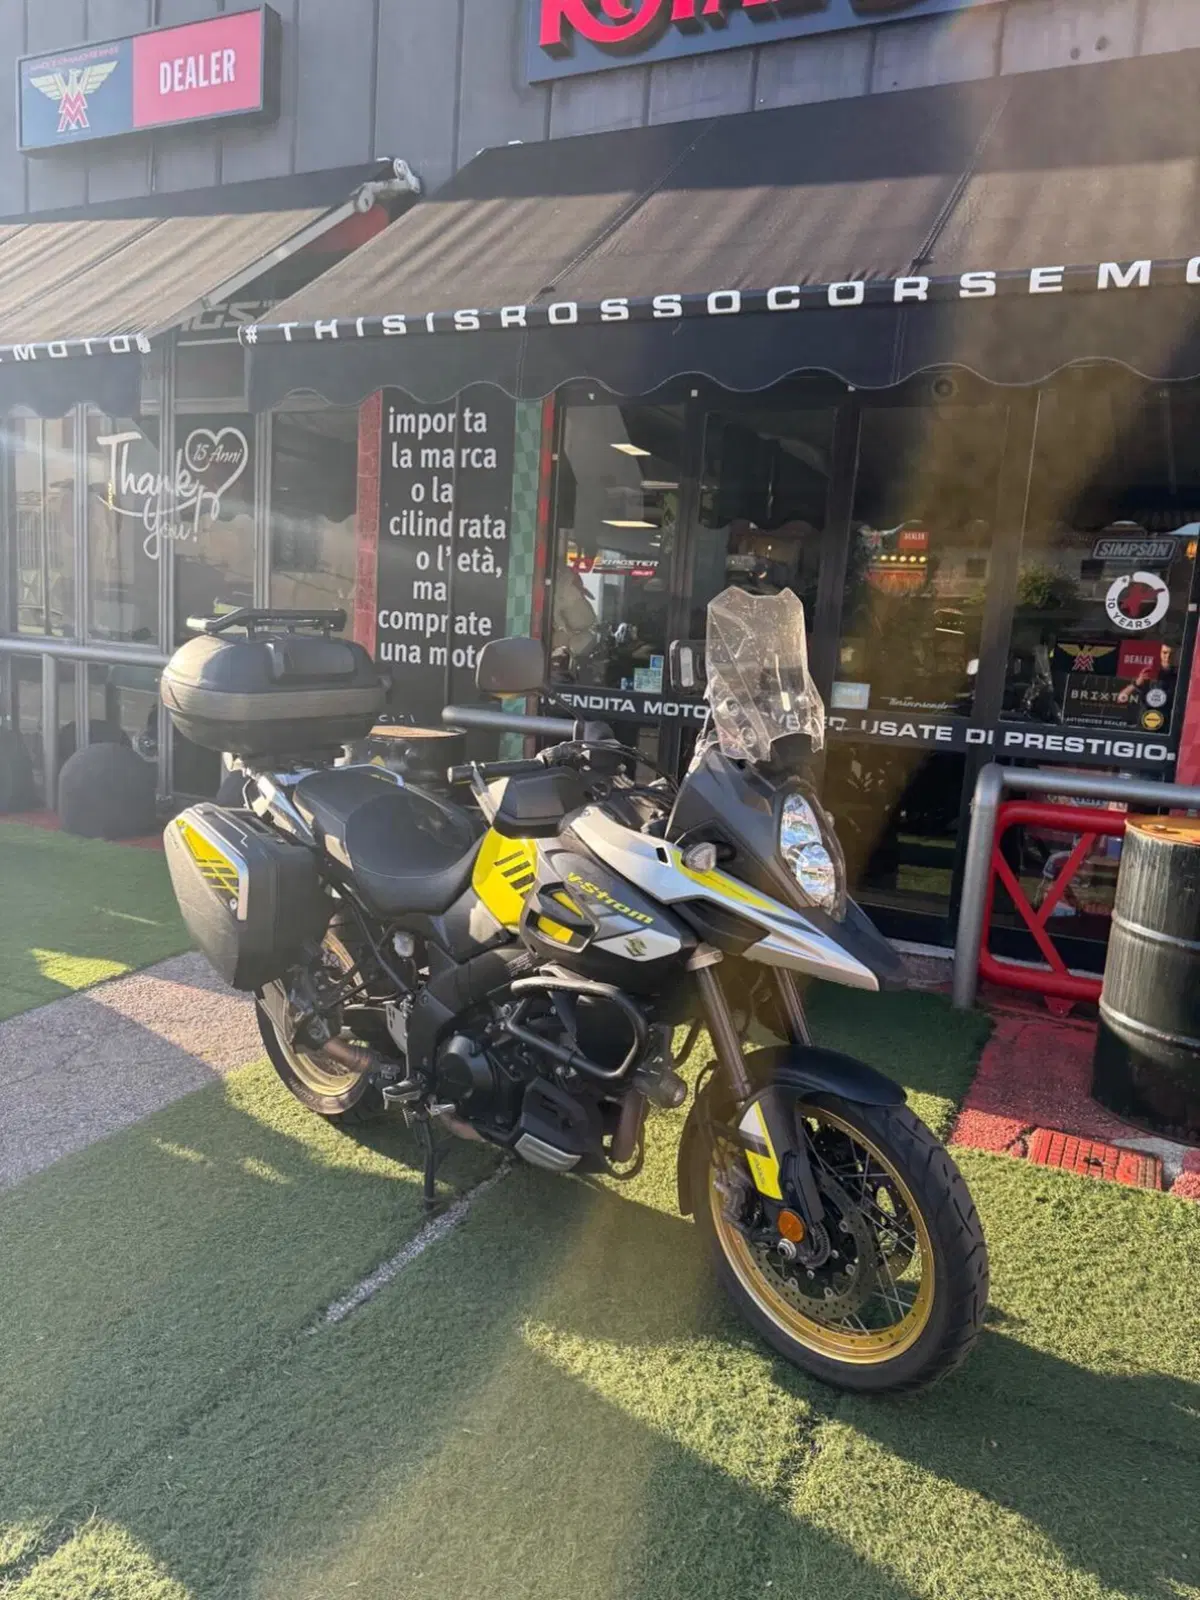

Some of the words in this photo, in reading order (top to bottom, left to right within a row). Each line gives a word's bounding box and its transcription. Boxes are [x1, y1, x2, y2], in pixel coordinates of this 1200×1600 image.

[159, 48, 236, 95] DEALER
[96, 431, 200, 497] Thank
[391, 441, 413, 469] la
[411, 483, 425, 503] o
[432, 476, 453, 503] la
[416, 551, 430, 571] o
[1100, 543, 1169, 557] SIMPSON
[412, 580, 447, 601] ma
[1112, 612, 1151, 629] YEARS
[380, 642, 422, 664] una
[1123, 655, 1154, 665] DEALER
[861, 719, 954, 742] USATE
[965, 727, 993, 745] DI
[1004, 731, 1177, 761] PRESTIGIO.
